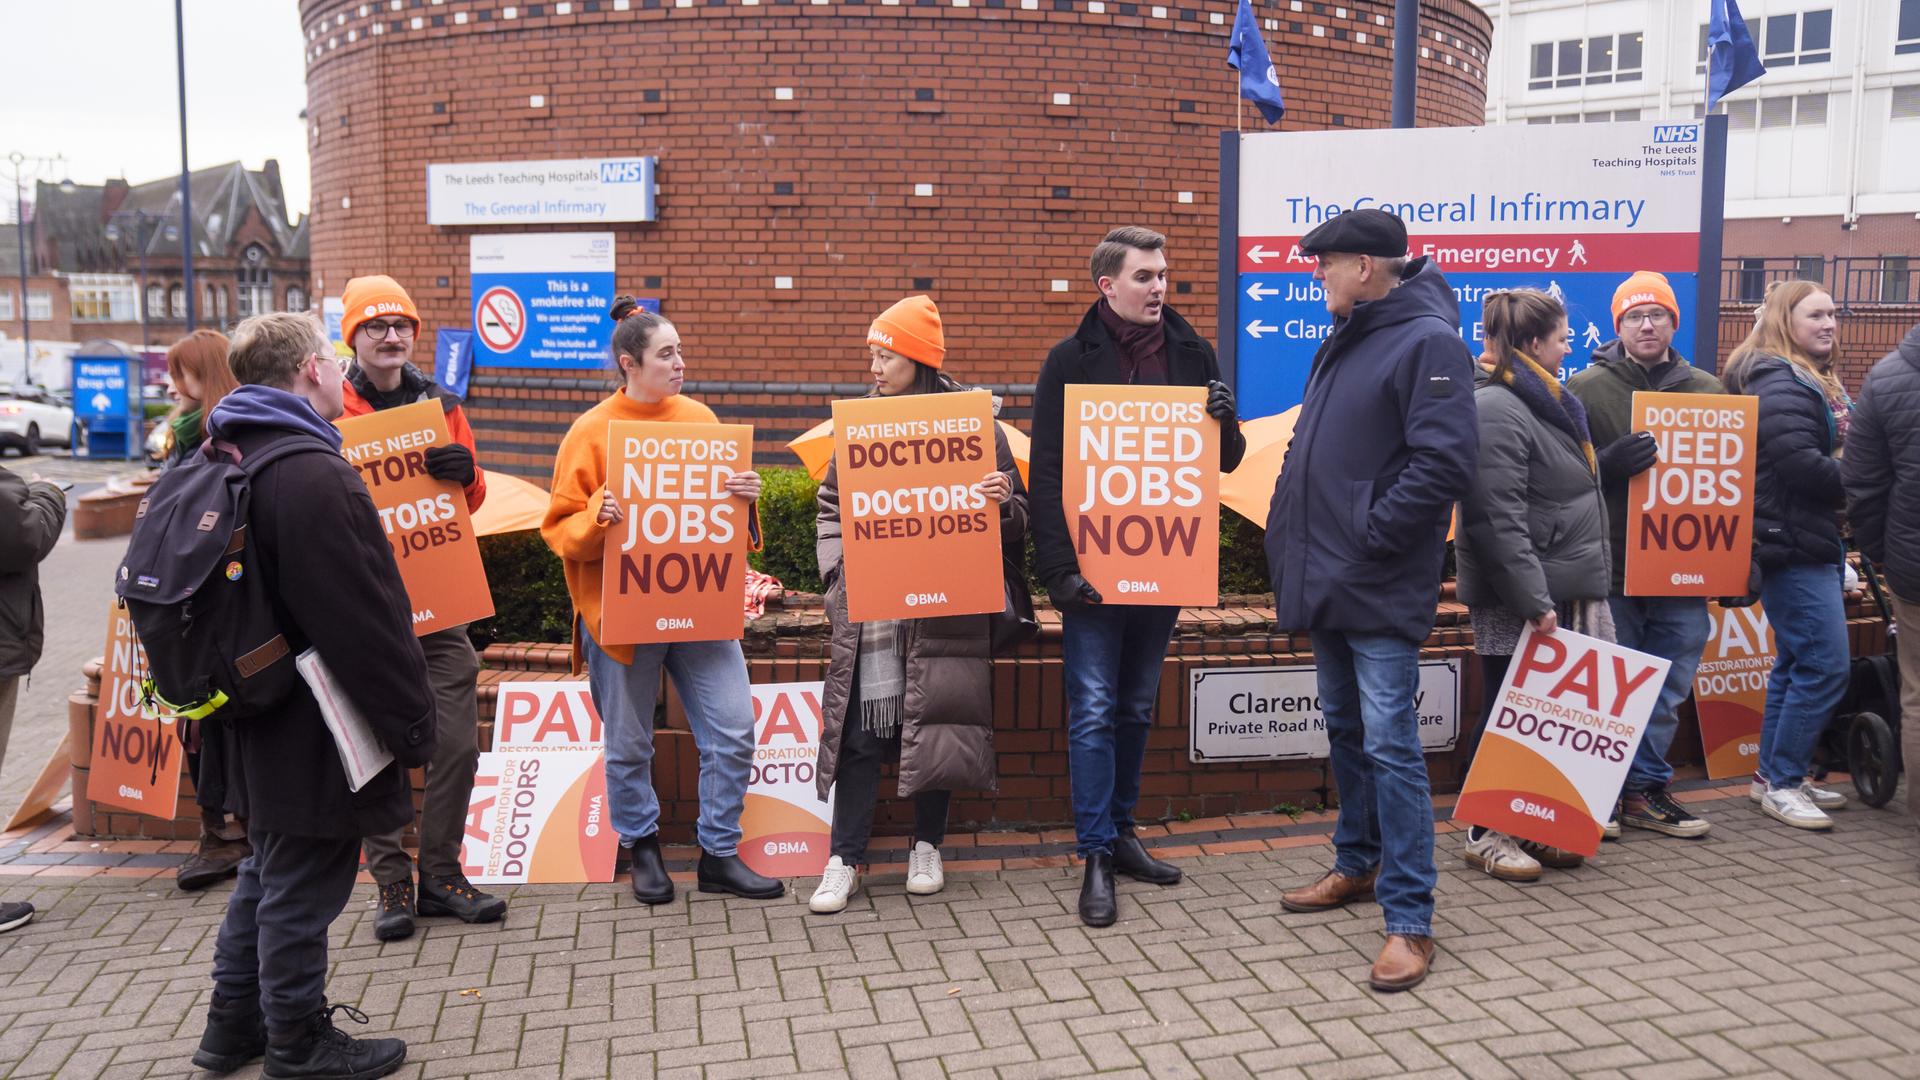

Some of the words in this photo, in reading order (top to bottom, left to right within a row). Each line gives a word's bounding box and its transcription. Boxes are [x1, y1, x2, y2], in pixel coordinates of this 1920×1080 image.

[1655, 126, 1696, 141] NHS
[1642, 146, 1661, 154] The
[1666, 145, 1696, 154] Leeds
[602, 163, 640, 183] NHS
[1592, 158, 1641, 168] Teaching
[1645, 156, 1697, 168] Hospitals
[445, 174, 463, 186] The
[465, 172, 495, 185] Leeds
[498, 172, 545, 185] Teaching
[548, 169, 598, 184] Hospitals
[464, 201, 487, 216] The
[490, 200, 540, 216] General
[544, 199, 607, 217] Infirmary
[1490, 192, 1645, 228] Infirmary
[1422, 243, 1559, 268] Emergency
[547, 280, 568, 292] This
[570, 280, 579, 292] is
[581, 283, 589, 292] a
[1631, 293, 1655, 303] BMA
[377, 302, 404, 313] BMA
[531, 295, 585, 308] smokefree
[586, 295, 606, 308] site
[449, 342, 460, 373] BMA
[80, 364, 121, 376] Patient
[77, 377, 105, 390] Drop
[1081, 400, 1204, 423] DOCTORS
[1645, 406, 1745, 429] DOCTORS
[386, 428, 437, 453] NEED
[846, 421, 929, 440] PATIENTS
[933, 417, 982, 435] NEED
[624, 437, 738, 461] DOCTORS
[848, 435, 983, 469] DOCTORS
[1079, 426, 1203, 462] NEED
[623, 463, 736, 500] NEED
[1079, 465, 1203, 512] JOBS
[1642, 467, 1742, 511] JOBS
[851, 483, 987, 517] DOCTORS
[378, 493, 456, 534] TORS
[621, 503, 735, 551] JOBS
[853, 517, 923, 541] NEED
[928, 512, 988, 540] JOBS
[1078, 514, 1202, 557] NOW
[1640, 513, 1740, 551] NOW
[402, 521, 462, 559] JOBS
[619, 552, 733, 595] NOW
[1681, 574, 1704, 585] BMA
[918, 593, 947, 604] BMA
[1131, 581, 1159, 593] BMA
[412, 609, 435, 624] MA
[669, 618, 694, 630] BMA
[1512, 631, 1659, 718] PAY
[1208, 720, 1263, 735] Private
[1268, 718, 1308, 733] Road
[1505, 691, 1605, 729] RESTORATION
[1606, 720, 1636, 739] FOR
[101, 721, 174, 771] NOW
[1496, 706, 1628, 763] DOCTORS
[487, 788, 512, 877] RESTORATION
[504, 758, 516, 786] FOR
[502, 758, 541, 877] DOCTORS
[588, 795, 602, 824] BMA
[1524, 801, 1555, 822] BMA
[778, 841, 808, 854] BMA
